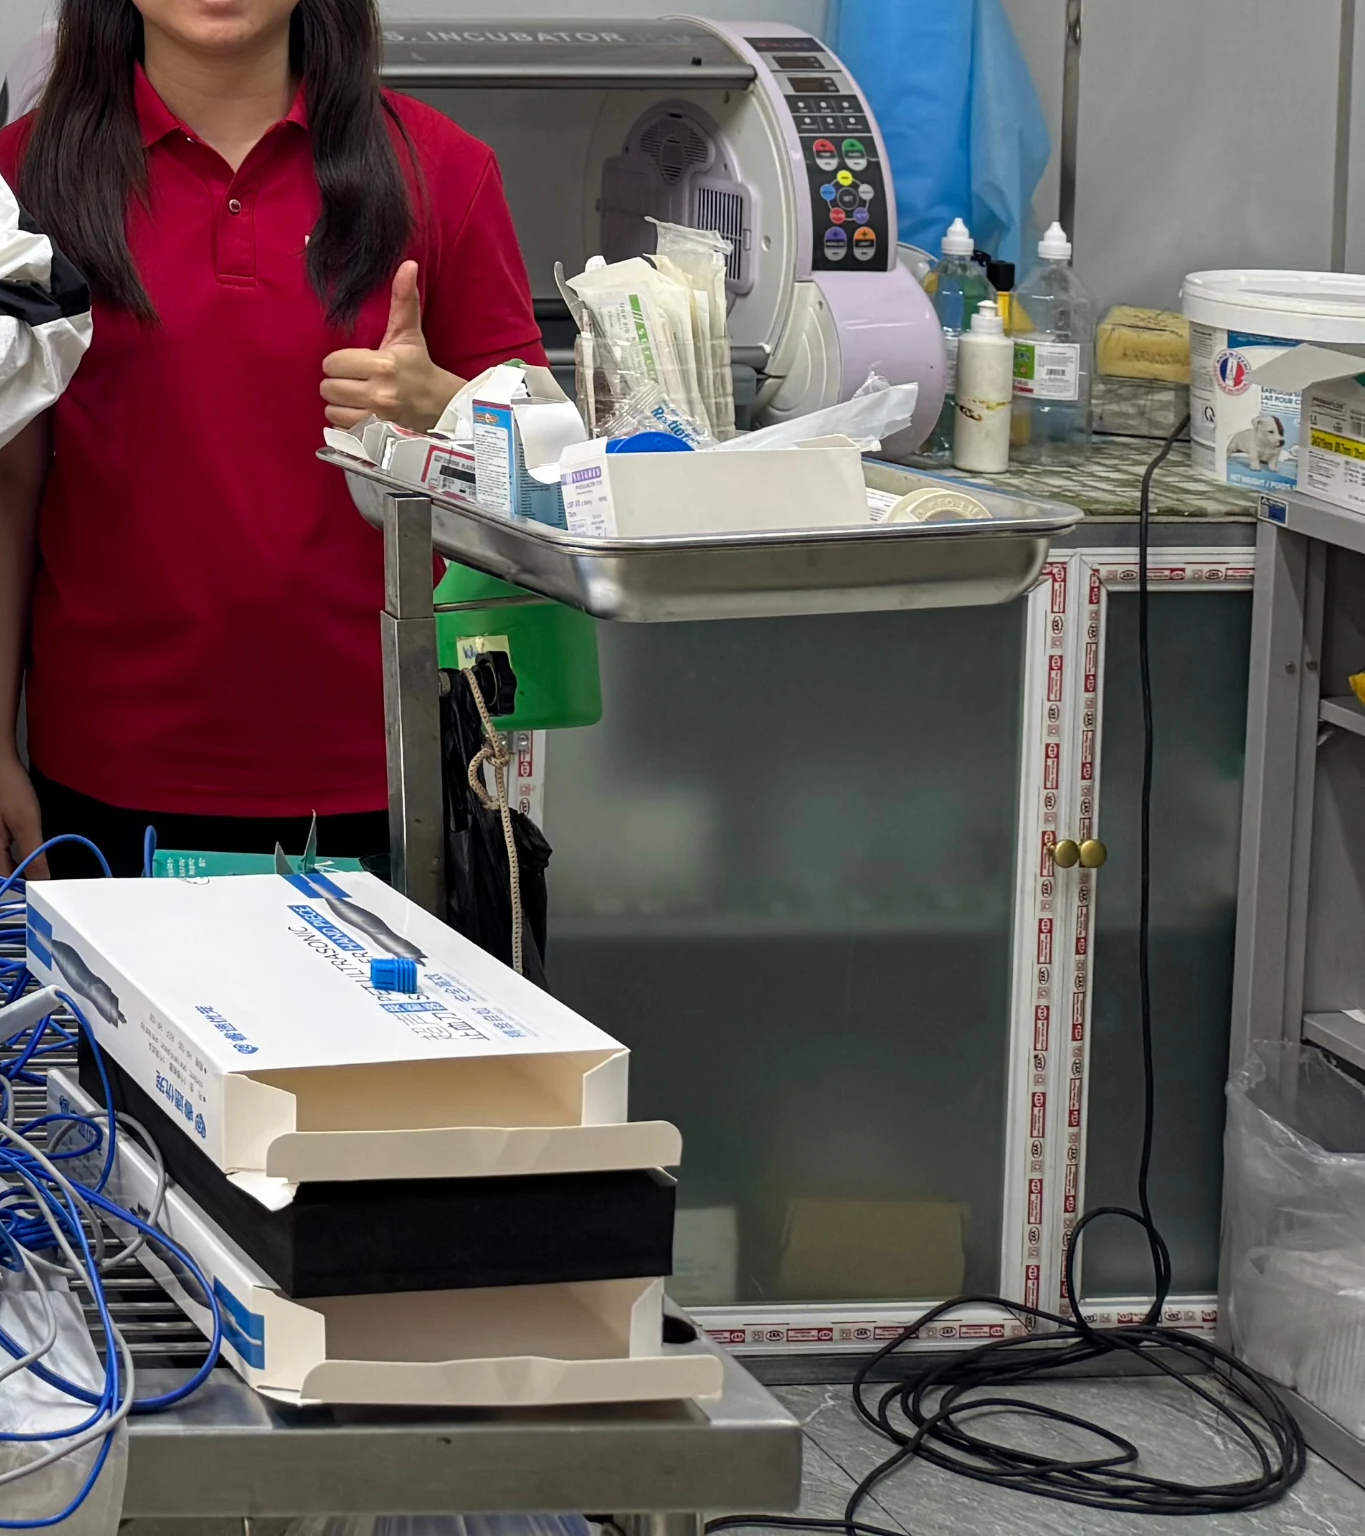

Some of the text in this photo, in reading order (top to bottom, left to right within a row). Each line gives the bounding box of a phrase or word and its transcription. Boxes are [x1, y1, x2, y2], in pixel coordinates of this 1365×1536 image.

[426, 30, 625, 44] INCUBATOR
[291, 905, 360, 951] HAND PIECE
[287, 926, 372, 984] ULTRASONIC
